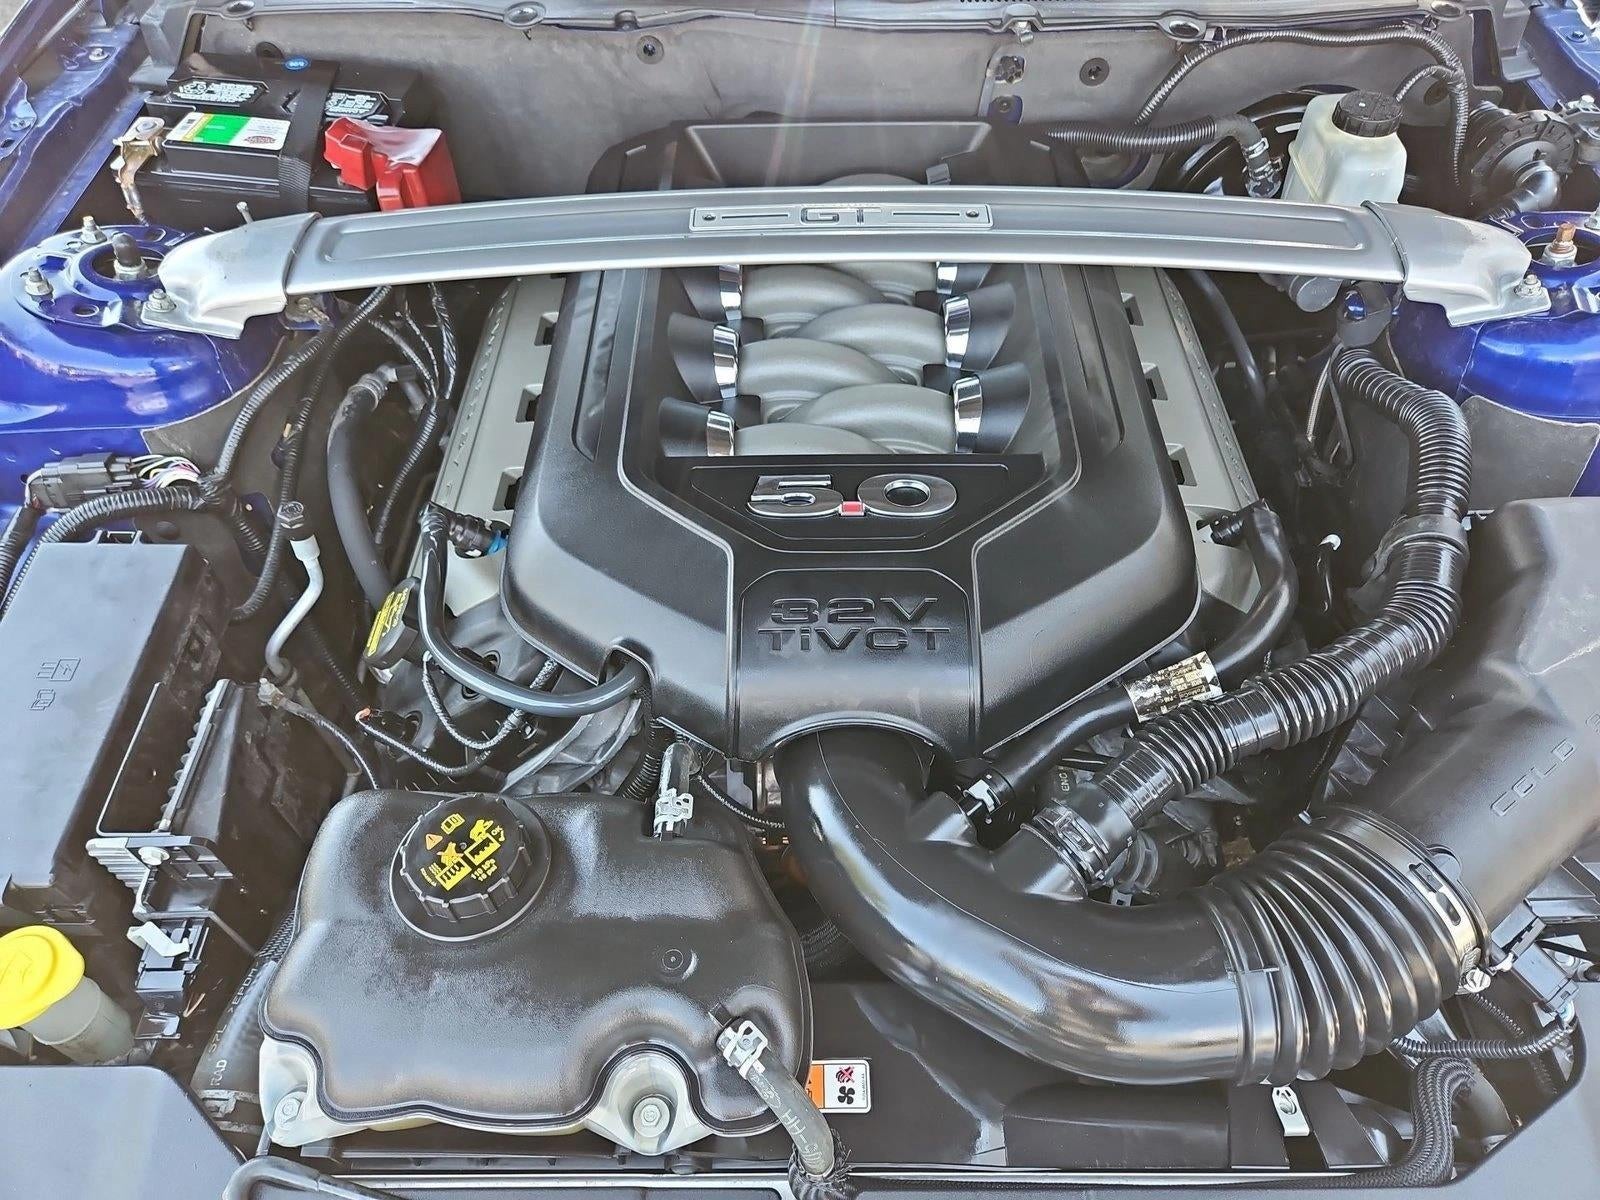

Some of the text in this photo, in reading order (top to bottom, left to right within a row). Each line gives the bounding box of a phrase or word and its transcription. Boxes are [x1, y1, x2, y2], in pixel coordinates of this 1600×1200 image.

[800, 206, 882, 226] GT
[747, 472, 957, 518] 5.0
[771, 597, 938, 624] 32V
[1490, 737, 1578, 817] COLD
